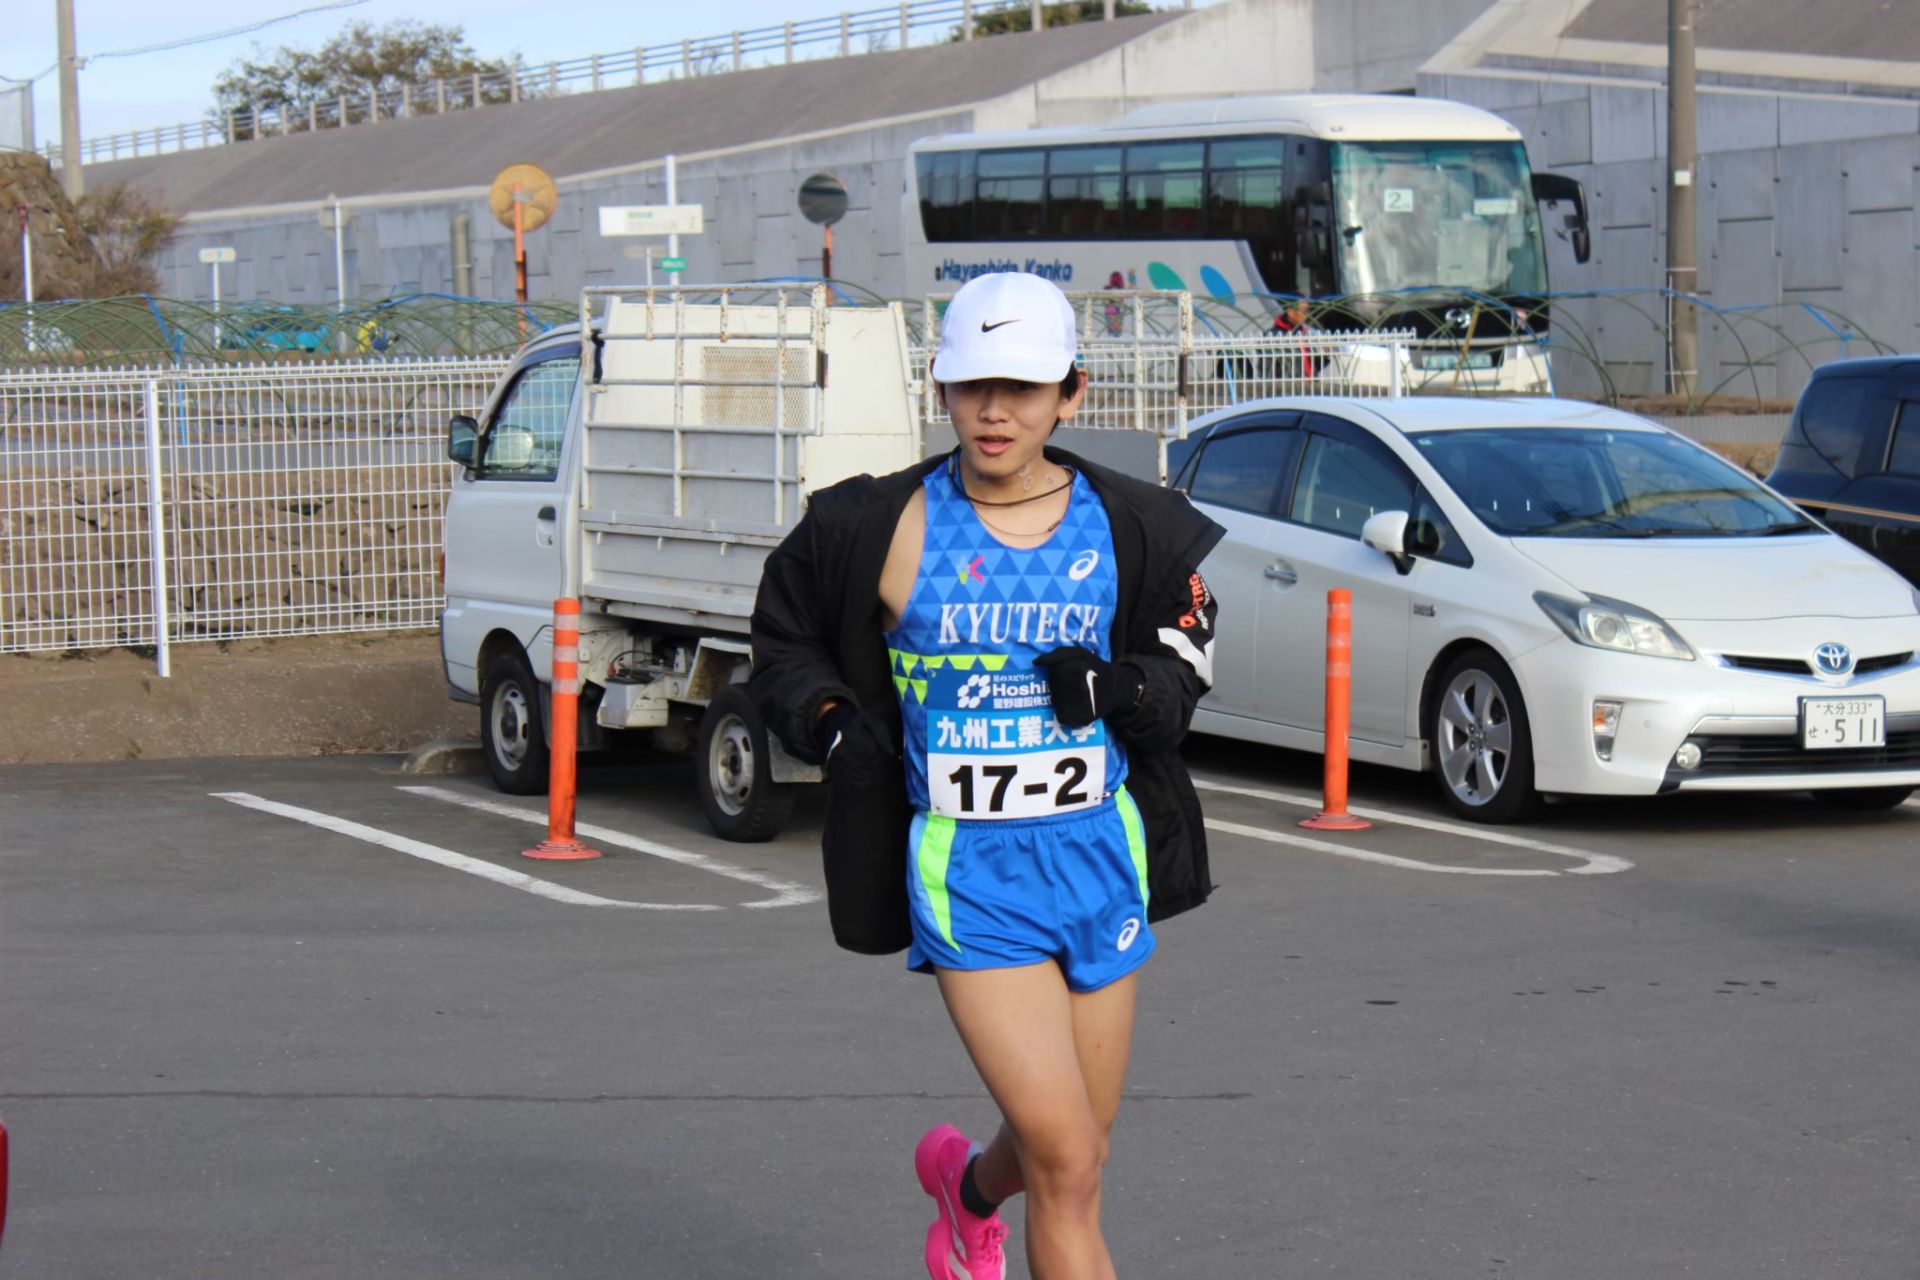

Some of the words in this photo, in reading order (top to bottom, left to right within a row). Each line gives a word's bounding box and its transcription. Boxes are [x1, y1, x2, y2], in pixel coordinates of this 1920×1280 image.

[943, 257, 1019, 282] Hayashida
[1024, 257, 1073, 281] Kanko
[938, 602, 1100, 644] KYUTECH
[949, 757, 1088, 812] 17-2
